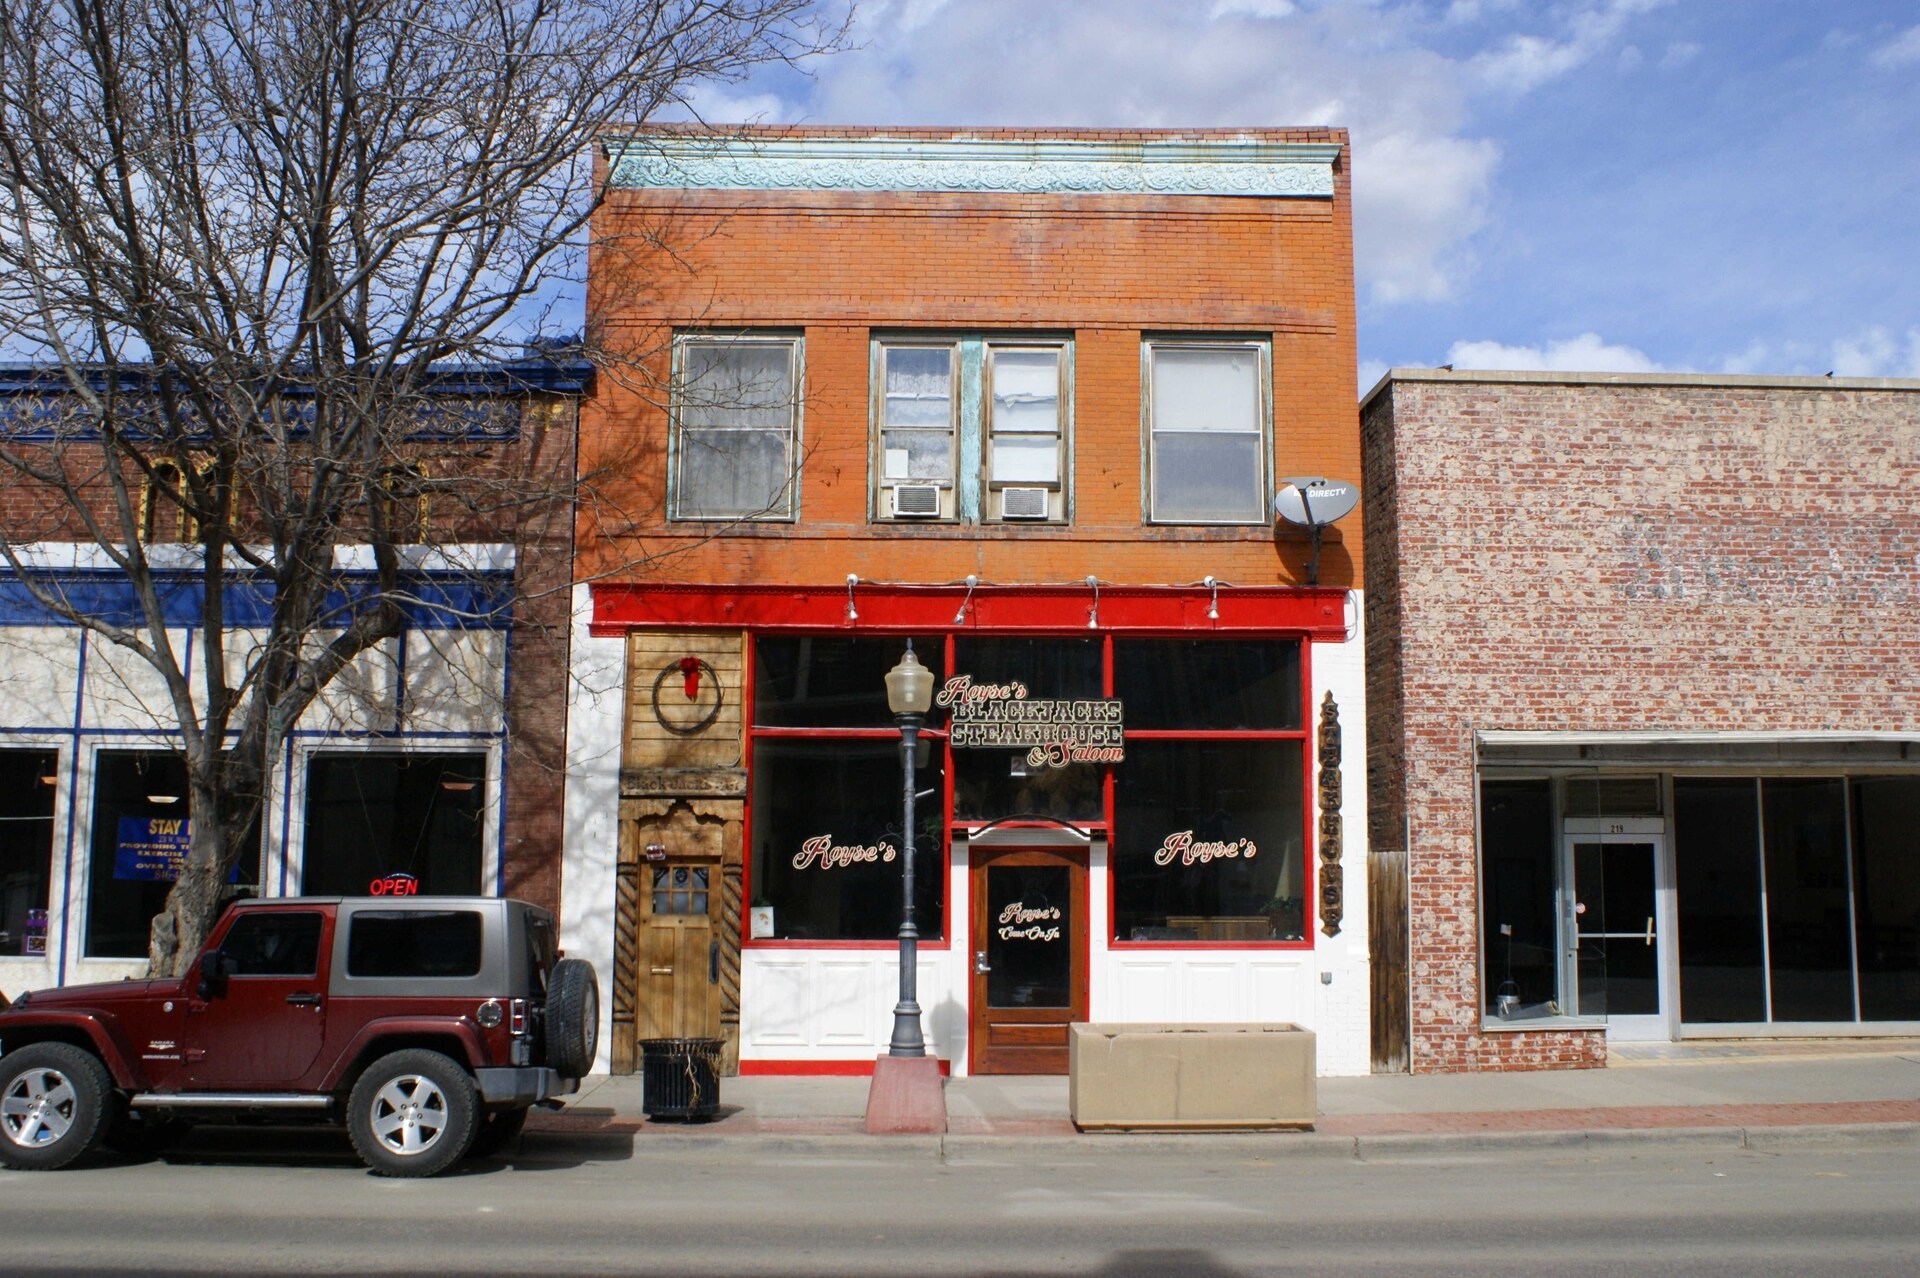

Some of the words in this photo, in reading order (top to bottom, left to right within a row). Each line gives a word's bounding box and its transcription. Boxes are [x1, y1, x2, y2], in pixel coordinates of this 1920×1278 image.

[1309, 488, 1346, 497] DIRECTV
[937, 675, 1026, 705] Royse's
[952, 701, 1121, 722] BLACKJACKS
[951, 724, 1123, 746] STEAKHOUSE
[1027, 747, 1048, 766] &
[1044, 738, 1124, 767] Saloon
[149, 819, 182, 835] STAY
[1610, 824, 1624, 833] 219
[120, 842, 177, 850] PROVIDING
[793, 834, 896, 870] Royse's
[1155, 830, 1257, 866] Royse's
[370, 879, 418, 896] OPEN
[999, 902, 1061, 924] Royse's
[998, 926, 1025, 940] Come
[1025, 926, 1045, 940] On
[1044, 927, 1060, 942] In
